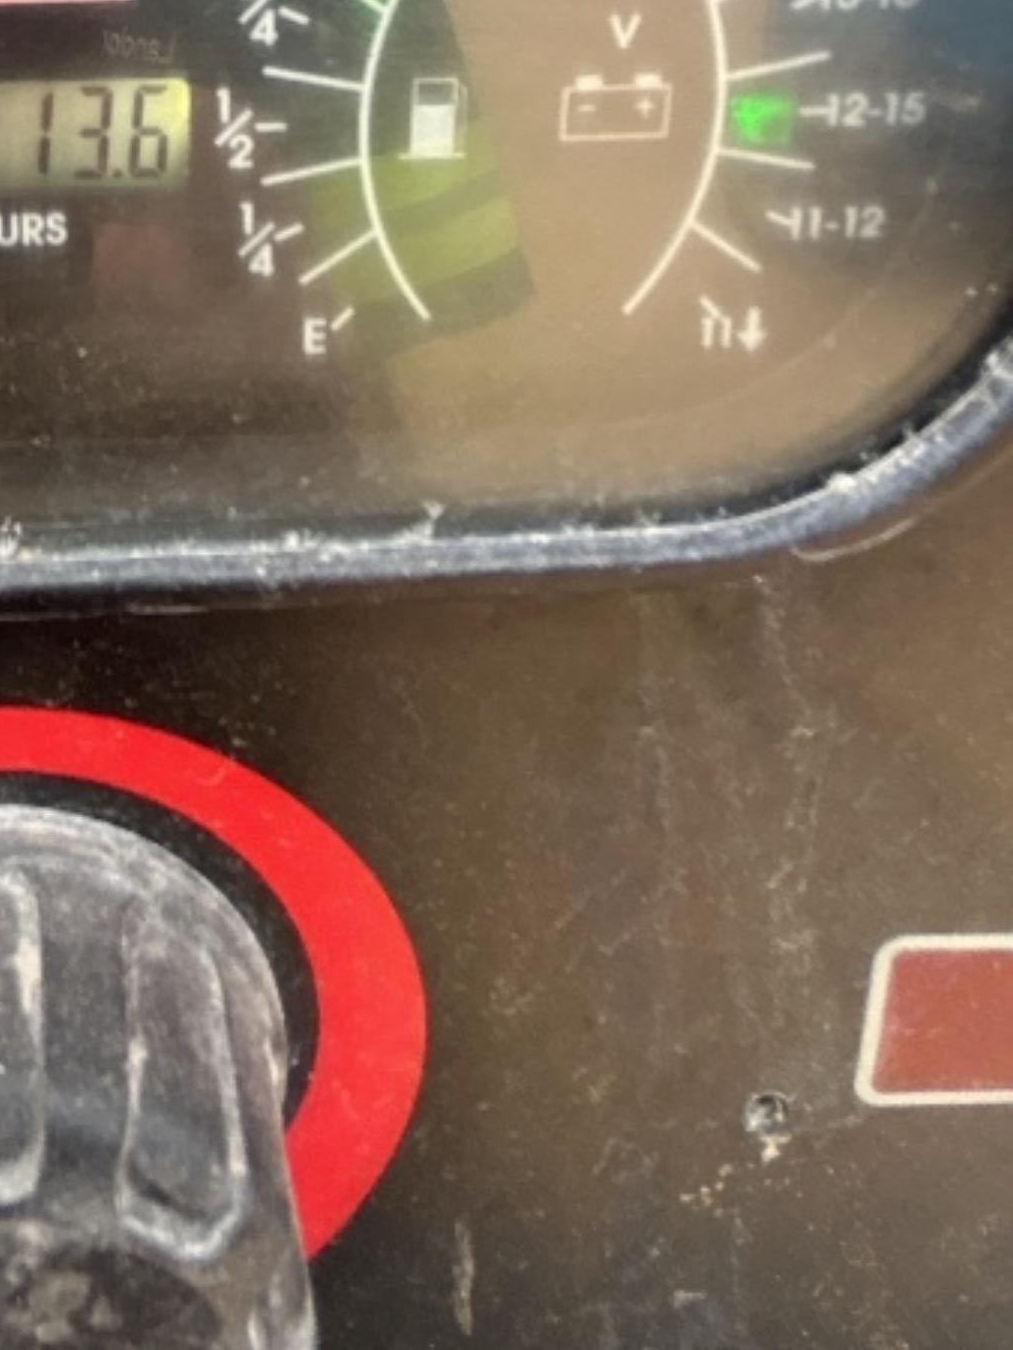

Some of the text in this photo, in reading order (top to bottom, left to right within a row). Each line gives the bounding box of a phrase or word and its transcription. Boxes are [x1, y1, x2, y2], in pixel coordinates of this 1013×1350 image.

[609, 13, 643, 49] V
[826, 91, 926, 127] 12-15
[302, 318, 328, 354] E
